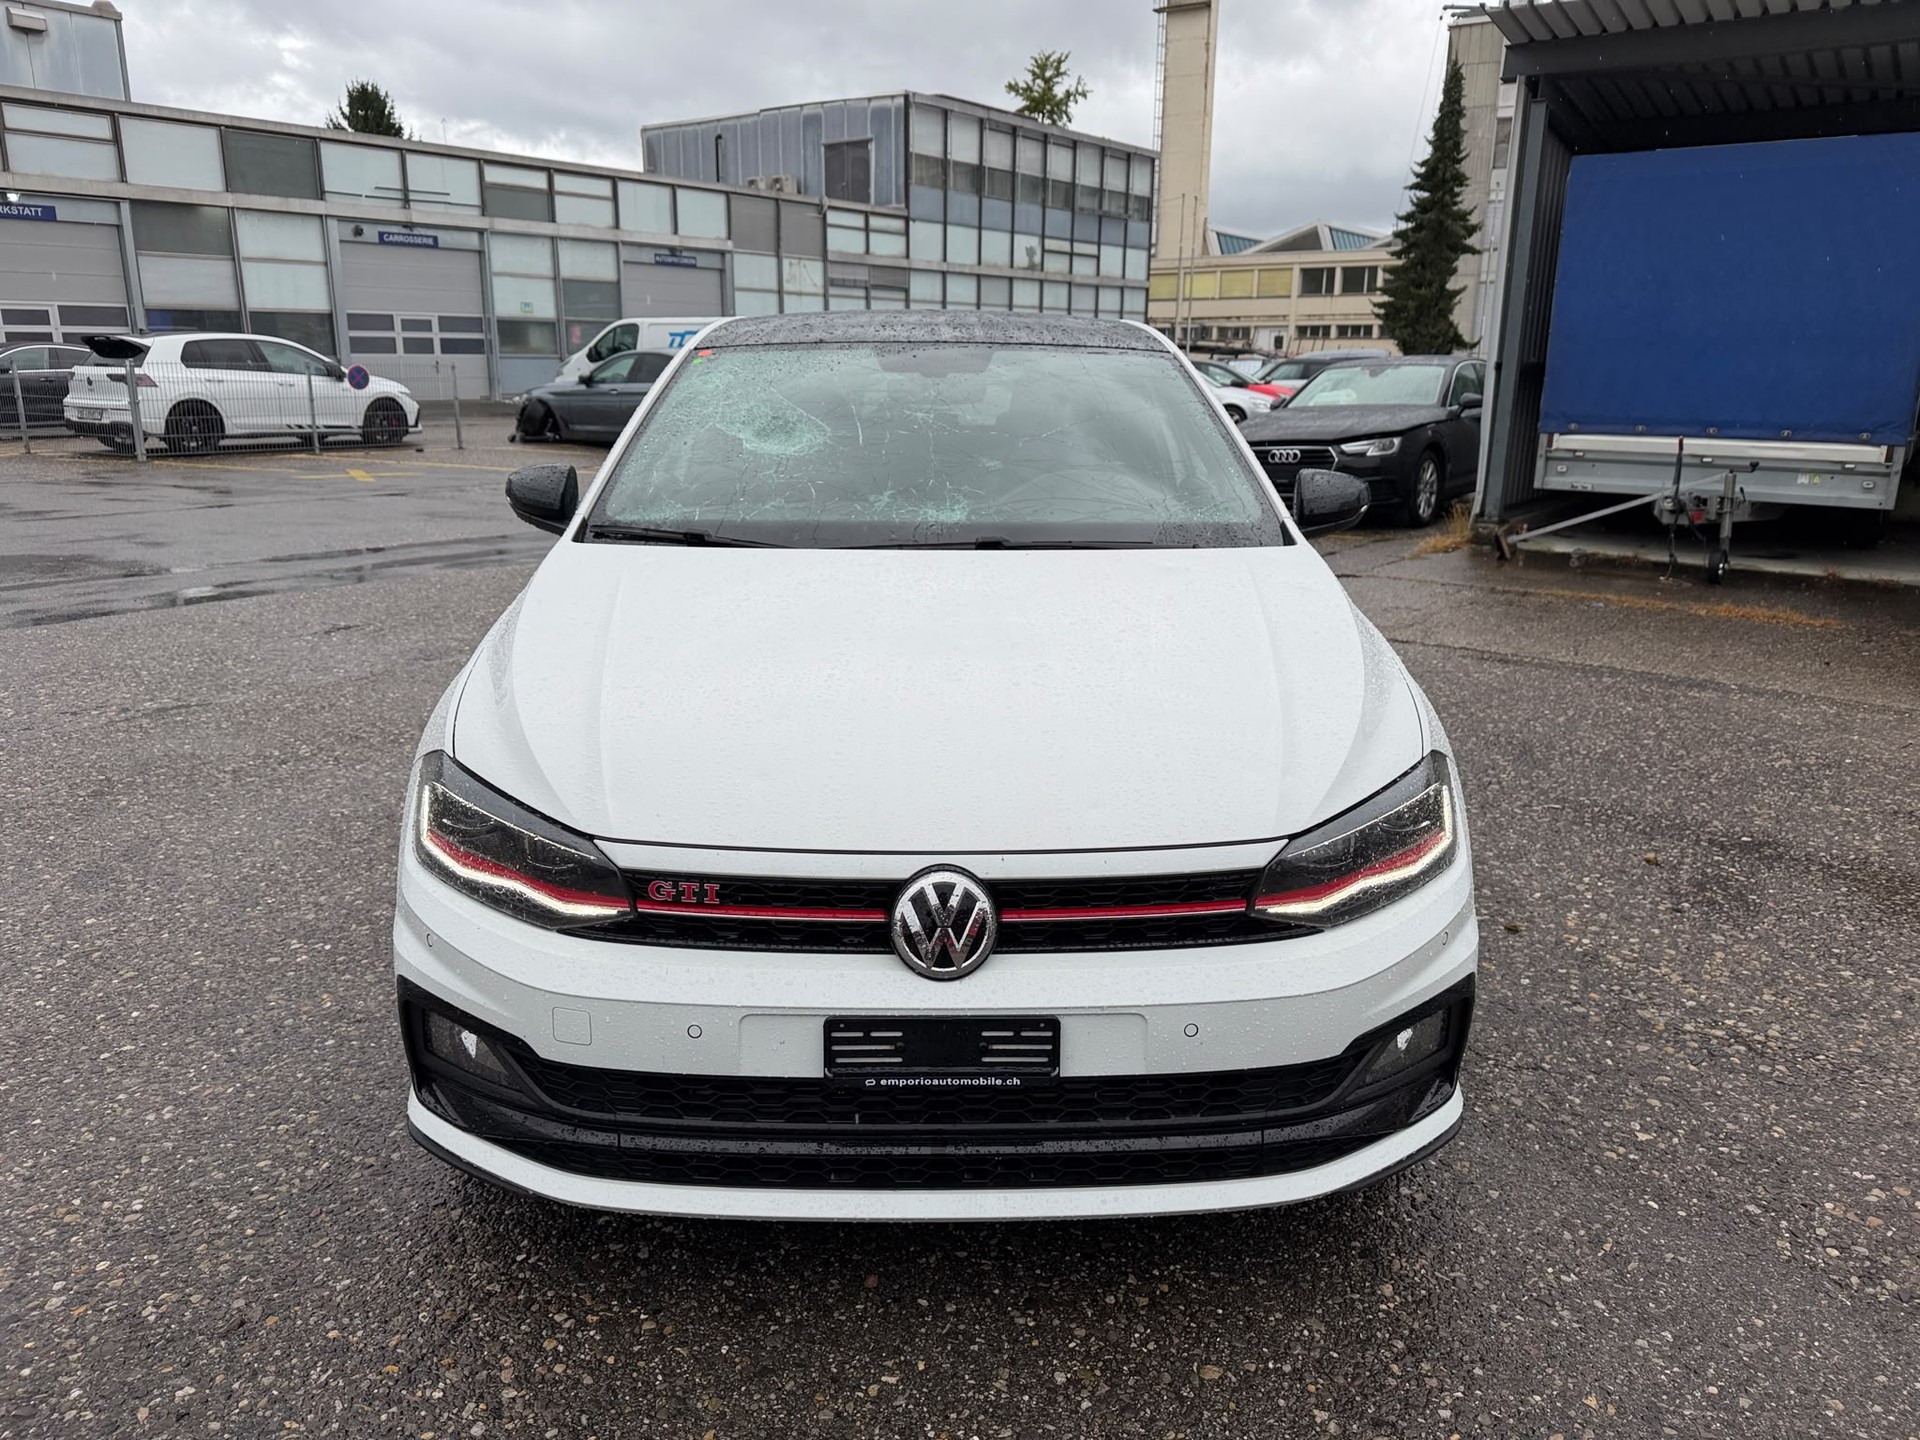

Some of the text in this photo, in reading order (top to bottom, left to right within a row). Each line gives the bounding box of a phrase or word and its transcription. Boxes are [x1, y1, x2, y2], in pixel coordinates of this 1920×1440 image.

[383, 233, 434, 245] CARROSSERIE
[648, 880, 720, 904] GTI
[880, 1077, 1021, 1087] emporioautomobile.ch
